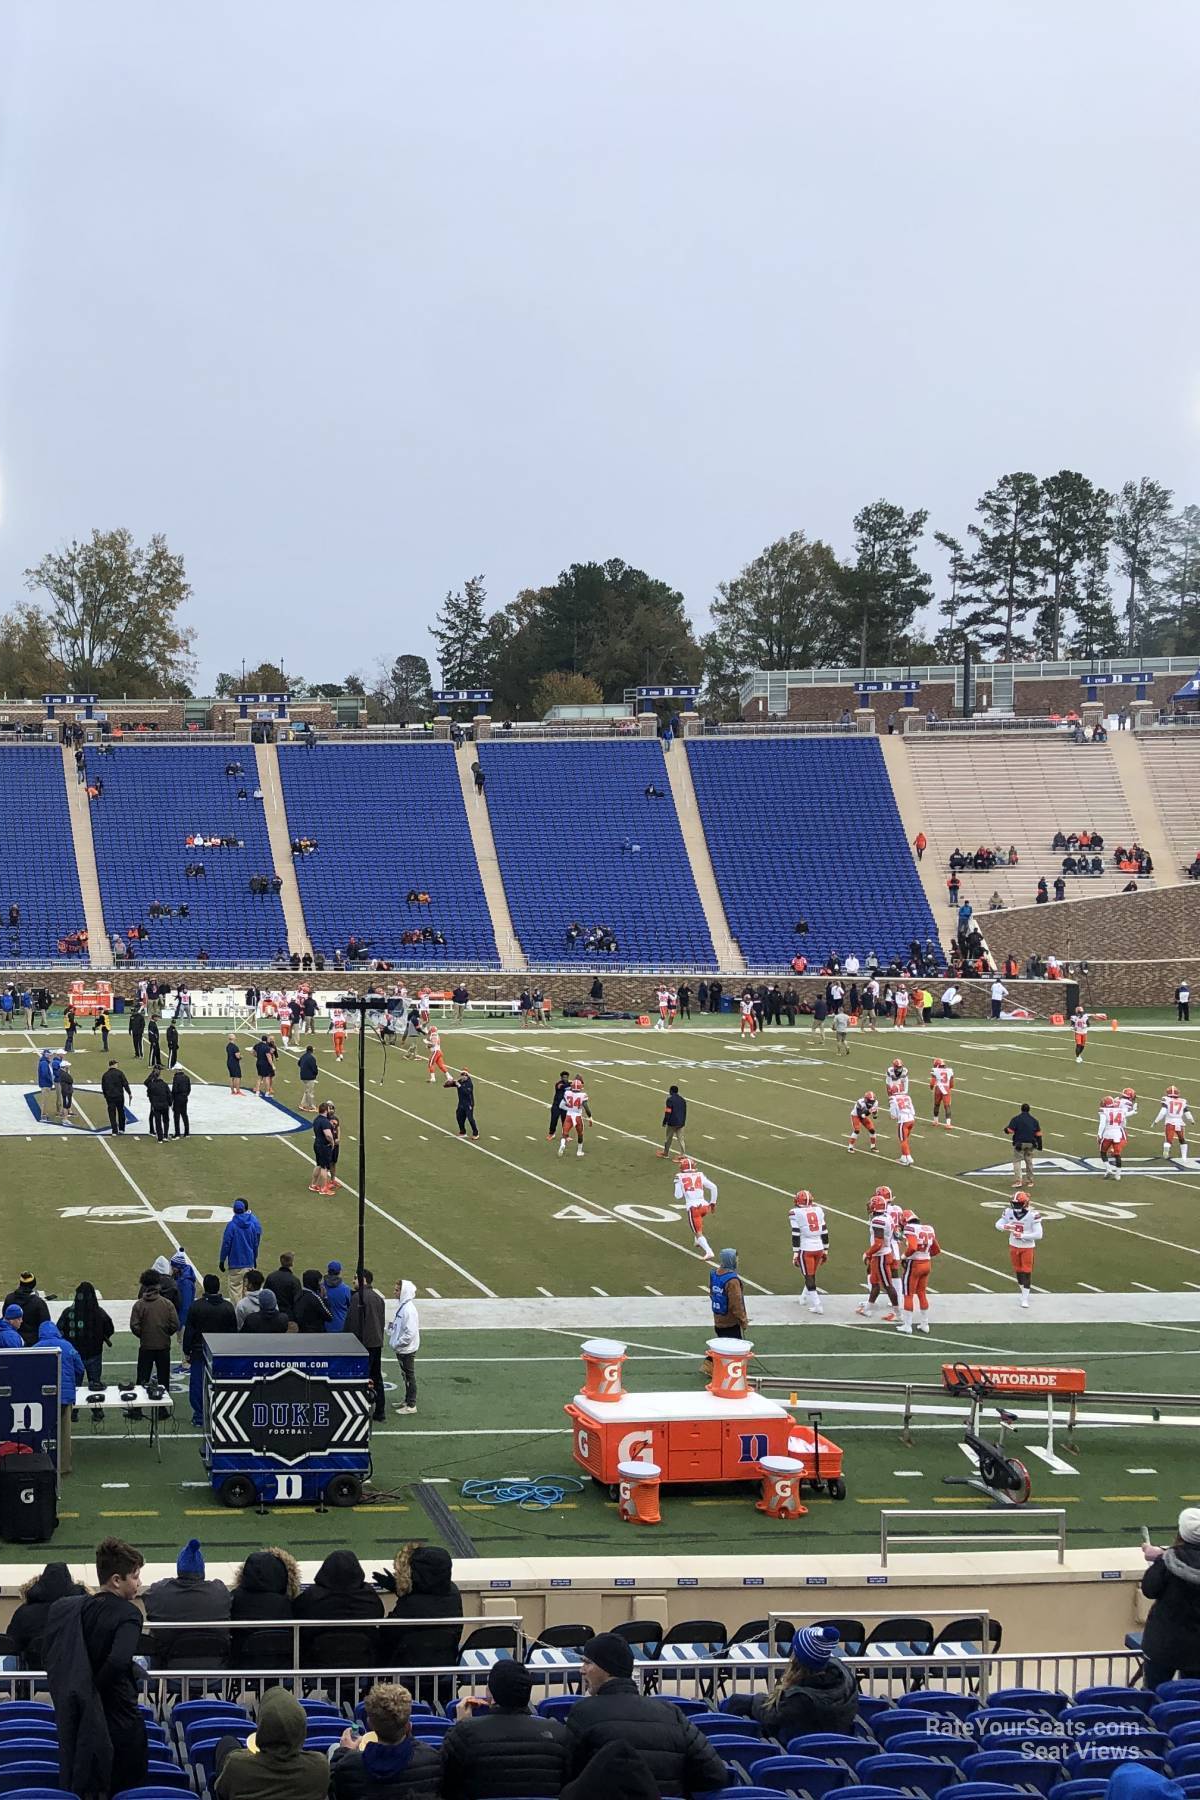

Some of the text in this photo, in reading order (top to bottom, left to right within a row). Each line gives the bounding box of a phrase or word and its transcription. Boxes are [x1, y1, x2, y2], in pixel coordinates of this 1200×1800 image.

[566, 1095, 582, 1110] 34
[1169, 1100, 1183, 1115] 17
[1109, 1111, 1122, 1126] 14
[552, 1204, 682, 1223] 40
[806, 1212, 820, 1232] 9
[253, 1360, 329, 1369] coachcomm.com
[603, 1364, 618, 1381] G
[727, 1361, 743, 1378] G
[252, 1402, 330, 1427] DUKE
[578, 1429, 589, 1458] G
[618, 1429, 654, 1463] G
[20, 1488, 35, 1504] G
[775, 1480, 792, 1497] G
